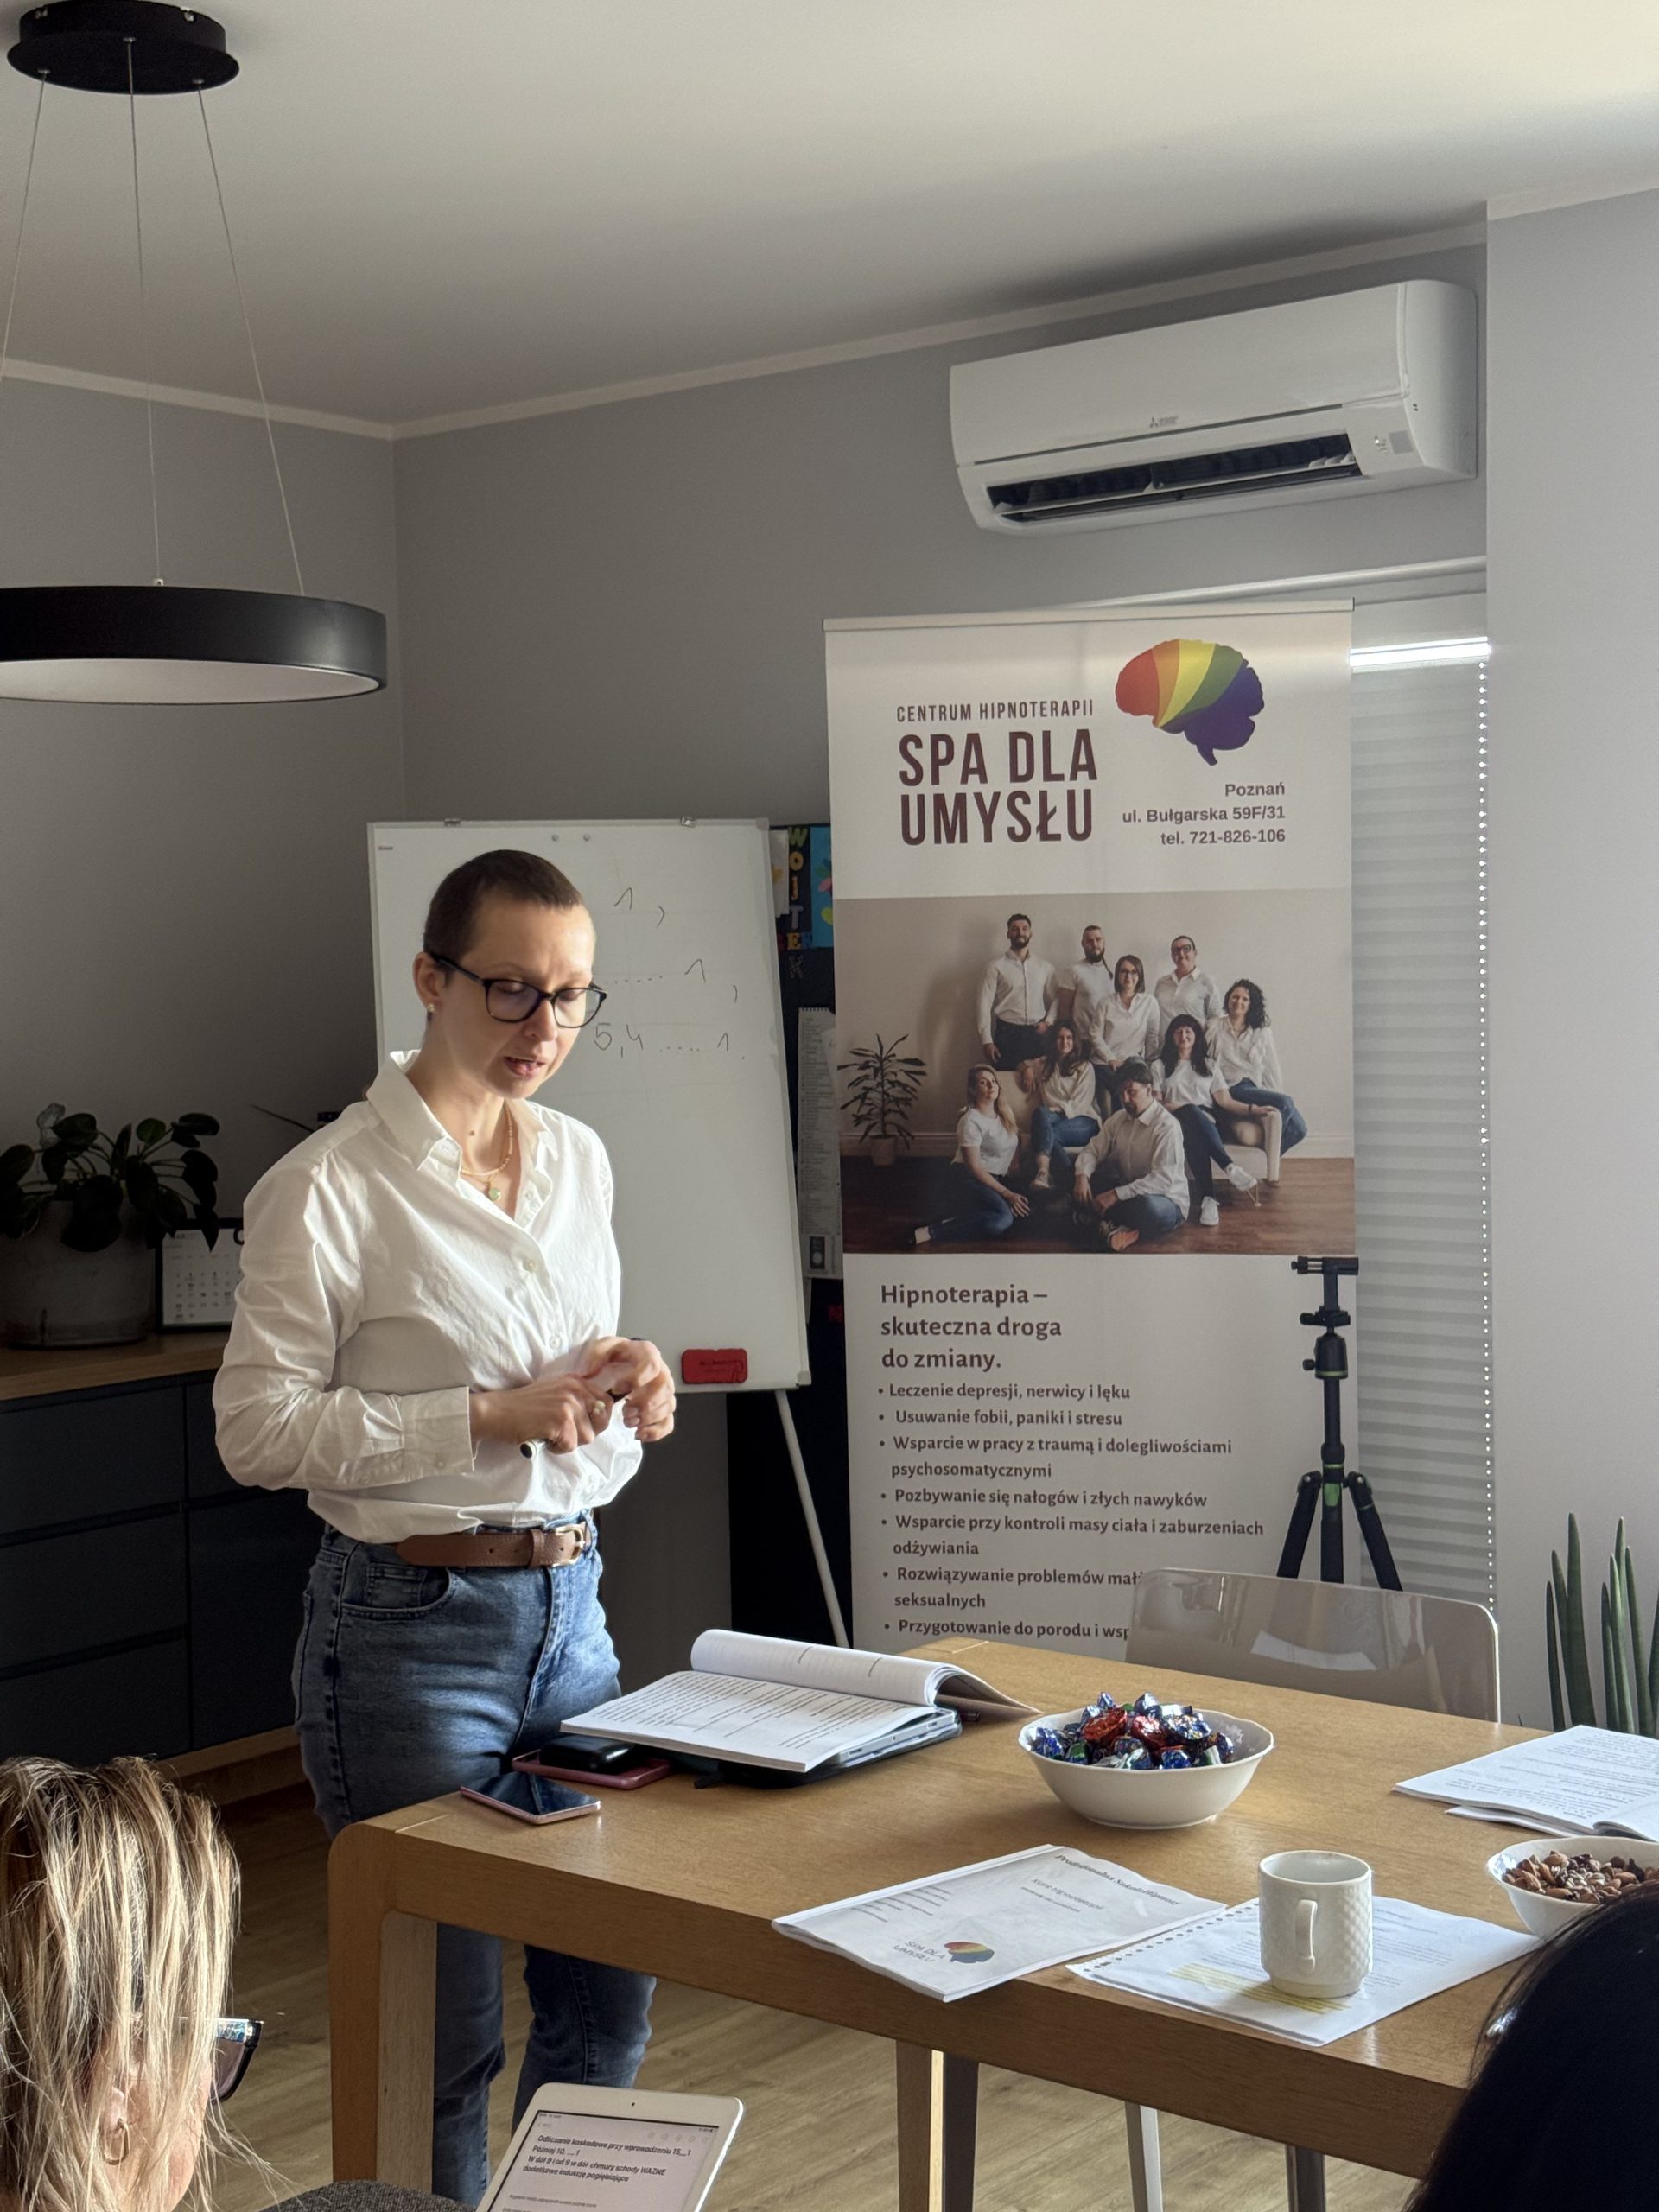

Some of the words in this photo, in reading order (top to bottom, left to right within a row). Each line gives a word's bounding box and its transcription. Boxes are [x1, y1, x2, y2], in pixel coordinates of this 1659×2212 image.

[897, 704, 971, 722] CENTRUM
[980, 700, 1092, 719] HIPNOTERAPII
[899, 733, 988, 786] SPA
[1009, 729, 1097, 783] DLA
[1225, 782, 1285, 797] Poznań
[901, 788, 1091, 845] UMYSŁU
[1123, 810, 1141, 823] ul.
[1147, 808, 1228, 824] Bułgarska
[1233, 806, 1285, 819] 59F/31
[1161, 831, 1184, 845] tel.
[1190, 830, 1285, 844] 721-826-106
[881, 1284, 1028, 1308] Hipnoterapia
[881, 1316, 991, 1336] skuteczna
[997, 1316, 1061, 1340] droga
[882, 1348, 908, 1368] do
[914, 1348, 1001, 1372] zmiany.
[890, 1382, 953, 1396] Leczenie
[957, 1382, 1022, 1400] depresji,
[1027, 1384, 1085, 1401] nerwicy
[1090, 1384, 1092, 1398] i
[1098, 1384, 1130, 1402] lęku
[896, 1409, 969, 1423] Usuwanie
[974, 1409, 1012, 1425] fobii,
[1017, 1410, 1064, 1427] paniki
[1068, 1411, 1071, 1424] i
[1076, 1414, 1122, 1425] stresu
[893, 1436, 963, 1452] Wsparcie
[967, 1440, 979, 1449] w
[983, 1440, 1023, 1453] pracy
[1027, 1440, 1034, 1450] z
[1038, 1440, 1094, 1455] traumą
[1098, 1438, 1102, 1452] i
[1106, 1438, 1231, 1456] dolegliwościami
[892, 1462, 1051, 1479] psychosomatycznymi
[896, 1488, 985, 1504] Pozbywanie
[989, 1490, 1009, 1507] się
[1014, 1490, 1078, 1507] nałogów
[1084, 1491, 1086, 1503] i
[1090, 1491, 1129, 1508] złych
[1134, 1492, 1207, 1510] nawyków
[896, 1515, 965, 1531] Wsparcie
[969, 1519, 1001, 1532] przy
[1005, 1516, 1064, 1530] kontroli
[1070, 1521, 1108, 1534] masy
[1112, 1518, 1147, 1532] ciała
[1152, 1519, 1155, 1533] i
[1160, 1519, 1263, 1535] zaburzeniach
[893, 1541, 979, 1556] odżywiania
[898, 1567, 1014, 1584] Rozwiązywanie
[1018, 1569, 1103, 1586] problemów
[895, 1592, 985, 1610] seksualnych
[899, 1620, 1010, 1636] Przygotowanie
[1014, 1621, 1033, 1635] do
[1037, 1623, 1090, 1638] porodu
[1095, 1624, 1098, 1637] i
